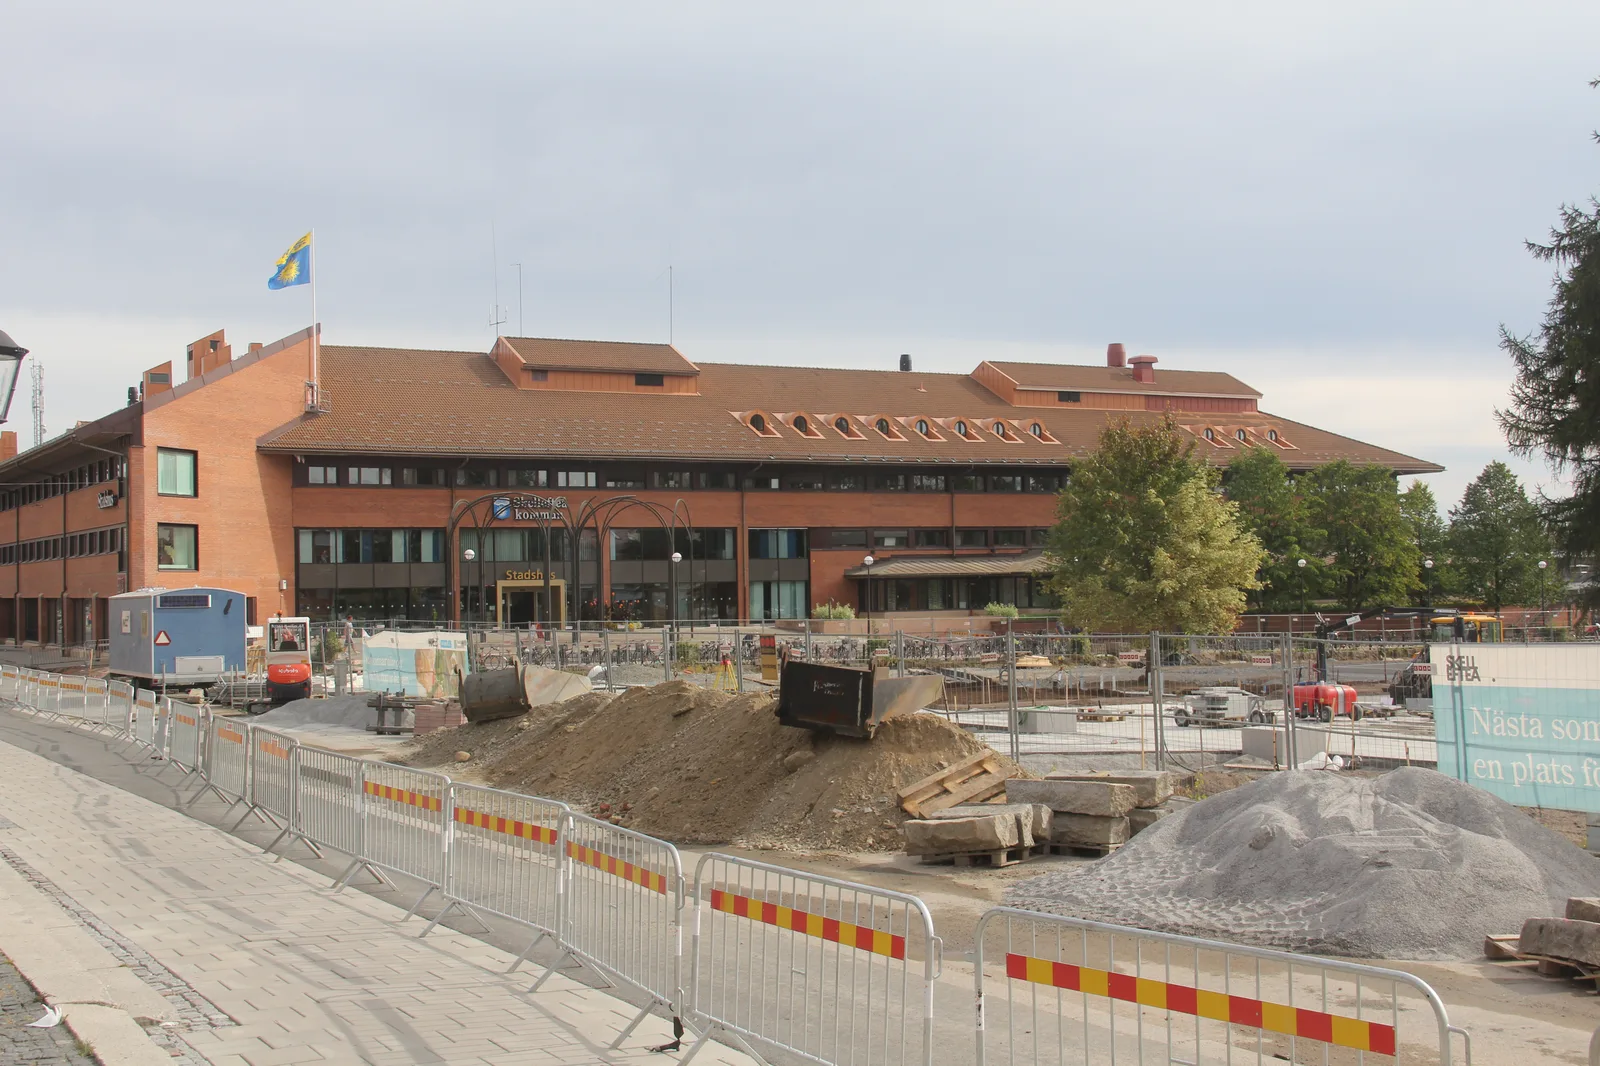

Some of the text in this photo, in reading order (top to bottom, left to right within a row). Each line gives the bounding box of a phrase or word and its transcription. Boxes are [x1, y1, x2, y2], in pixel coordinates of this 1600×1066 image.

[506, 569, 556, 580] Stadshs
[1471, 707, 1544, 739] Nästa
[1474, 758, 1504, 780] en
[1511, 753, 1575, 788] plats
